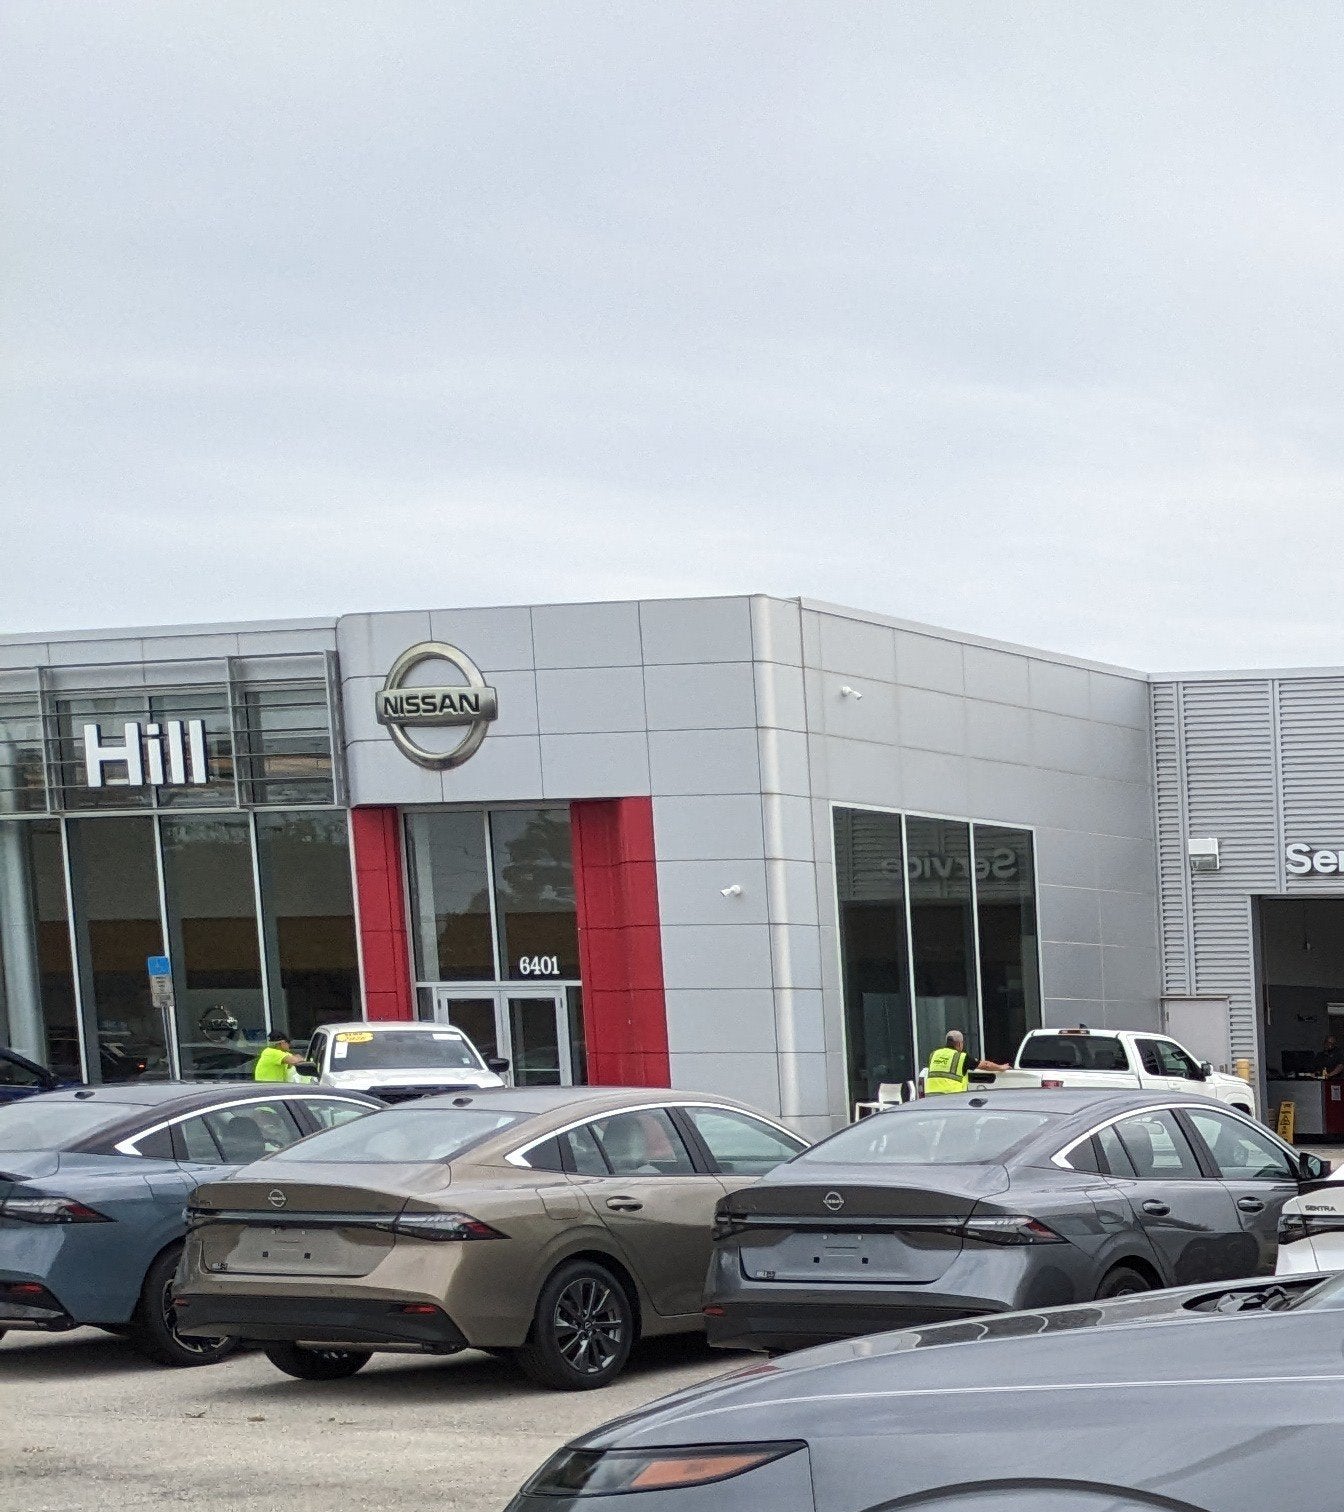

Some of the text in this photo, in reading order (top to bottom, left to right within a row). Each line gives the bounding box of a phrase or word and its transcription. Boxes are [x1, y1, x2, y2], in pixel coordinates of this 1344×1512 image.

[383, 693, 480, 716] NISSAN
[84, 719, 208, 788] Hill
[519, 955, 561, 975] 6401
